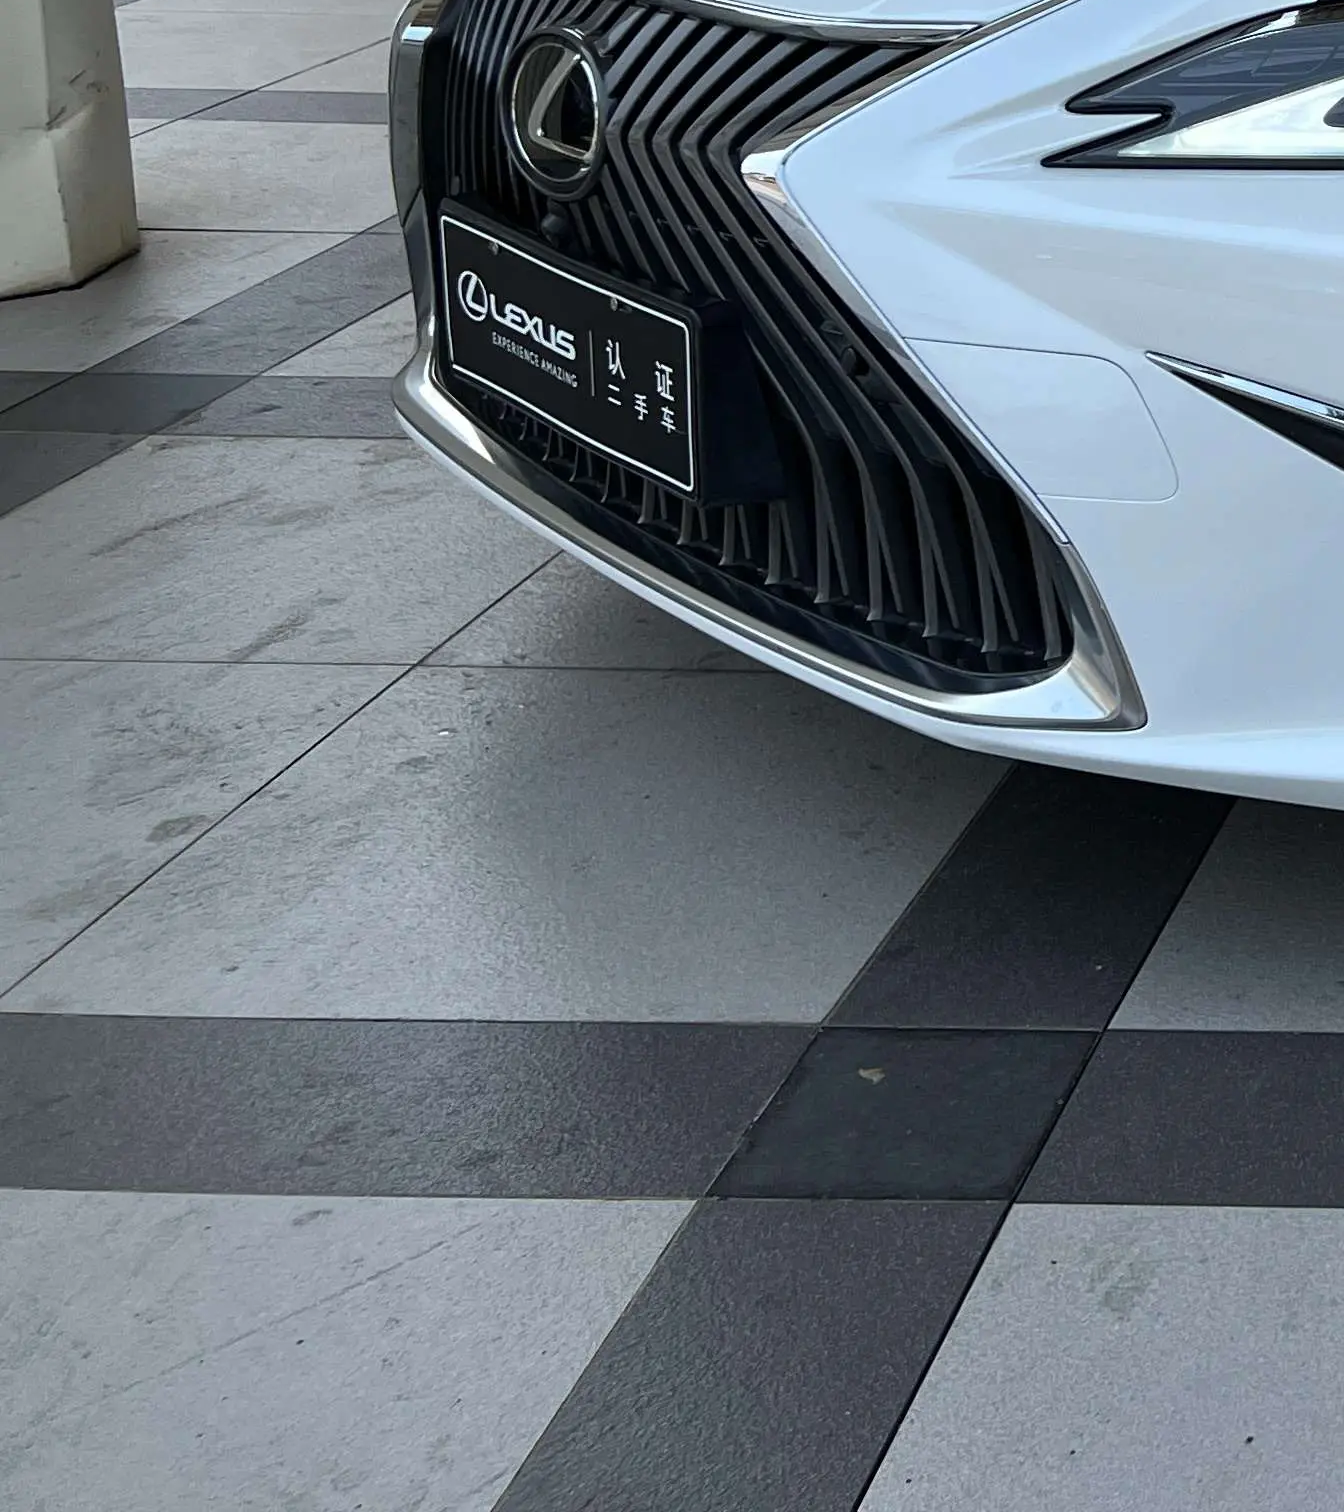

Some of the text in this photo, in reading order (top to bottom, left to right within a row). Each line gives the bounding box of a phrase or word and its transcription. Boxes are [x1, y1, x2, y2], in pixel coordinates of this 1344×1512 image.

[489, 293, 577, 361] LEXUS
[491, 331, 579, 388] EXPERIENCE AMAZING
[605, 339, 675, 402] 认证
[607, 383, 677, 434] 二手车
